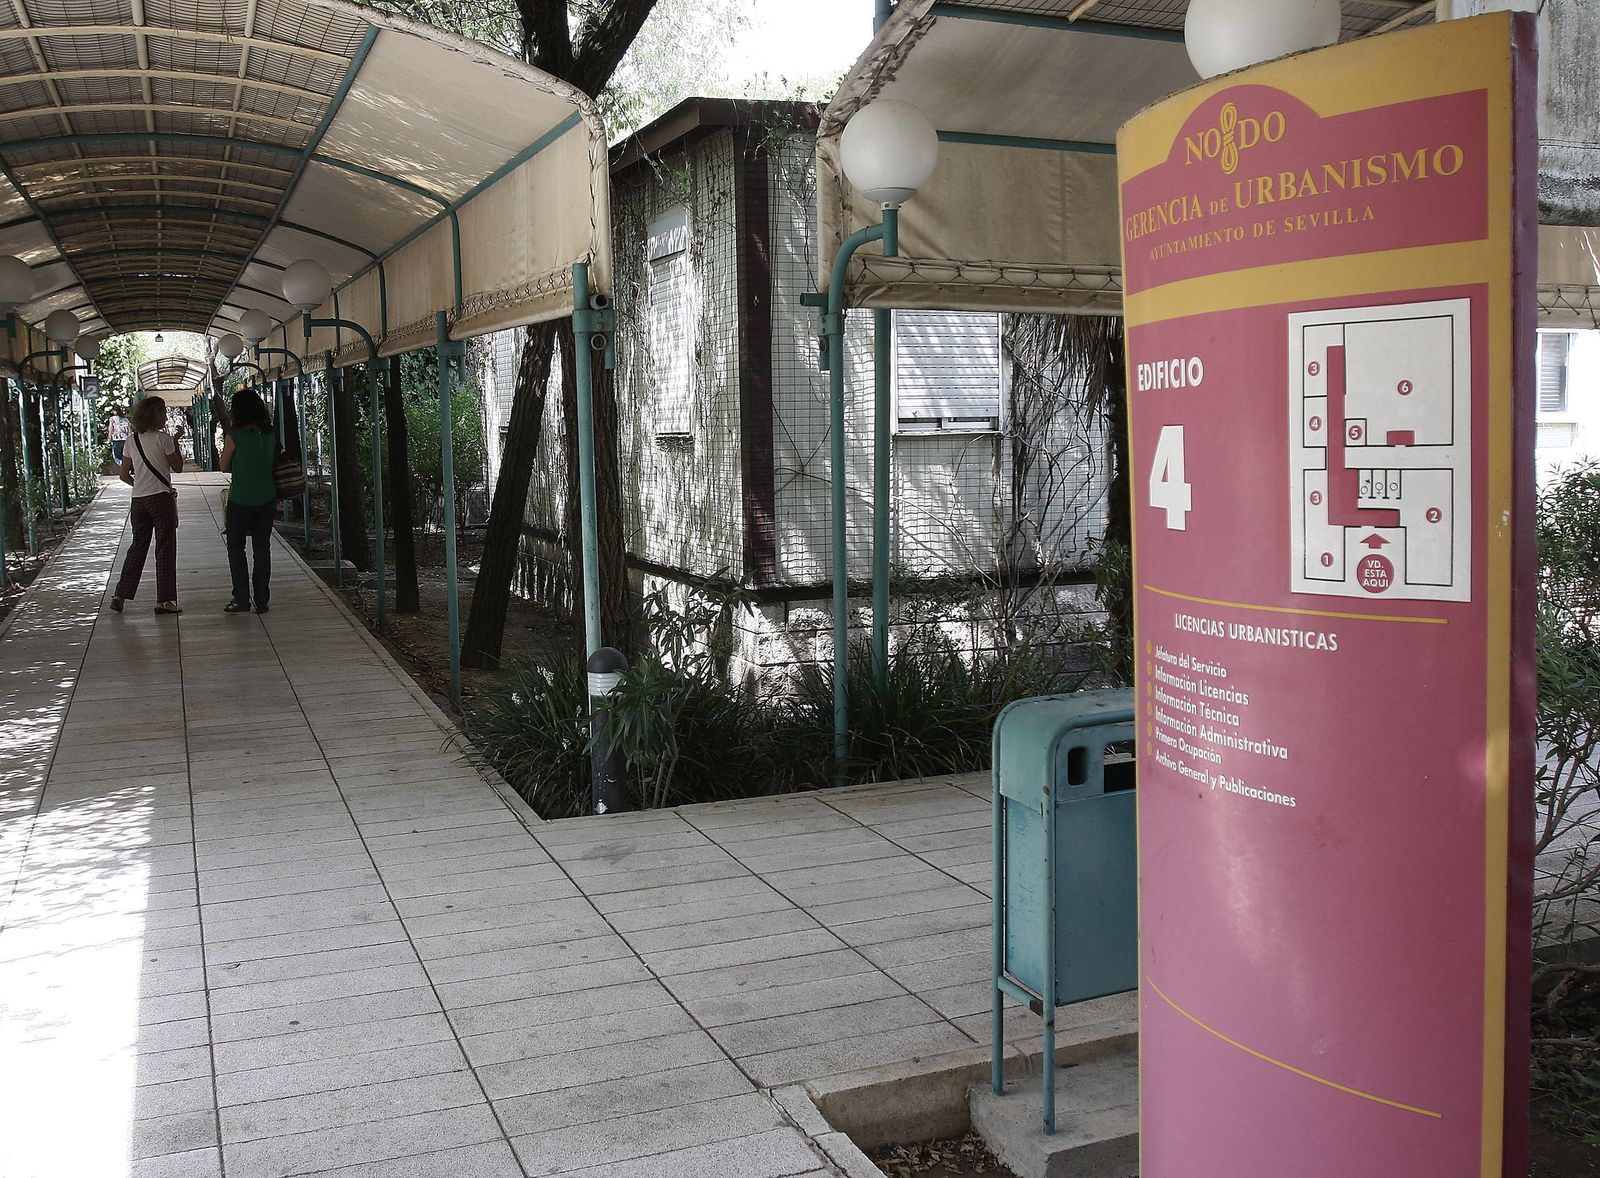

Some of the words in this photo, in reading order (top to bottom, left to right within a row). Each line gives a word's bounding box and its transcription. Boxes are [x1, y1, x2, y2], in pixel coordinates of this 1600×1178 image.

[1126, 193, 1204, 242] GERENCIA
[1209, 198, 1229, 215] DE
[1234, 144, 1464, 209] URBANISMO
[1149, 225, 1245, 262] AYUNTAMIENTO
[1253, 220, 1276, 237] DE
[1284, 205, 1376, 232] SEVILLA
[86, 385, 98, 397] 2
[1138, 356, 1205, 392] EDIFICIO
[1149, 424, 1193, 532] 4
[1363, 578, 1389, 588] AQUI
[1364, 569, 1388, 578] ESTA
[1367, 560, 1384, 569] VD.
[1174, 612, 1225, 638] LICENCIAS
[1229, 622, 1339, 652] URBANISTICAS
[1155, 665, 1197, 693] Información
[1200, 679, 1249, 705] Licencias
[1179, 652, 1190, 669] del
[1192, 656, 1228, 678] Servicio
[1155, 685, 1197, 714] Información
[1200, 701, 1240, 726] Técnica
[1155, 706, 1197, 737] Información
[1200, 724, 1288, 760] Administrativa
[1179, 737, 1222, 765] Ocupación
[1155, 749, 1177, 771] Archivo
[1179, 760, 1209, 784] General
[1210, 775, 1218, 791] y
[1219, 775, 1296, 808] Publicaciones
